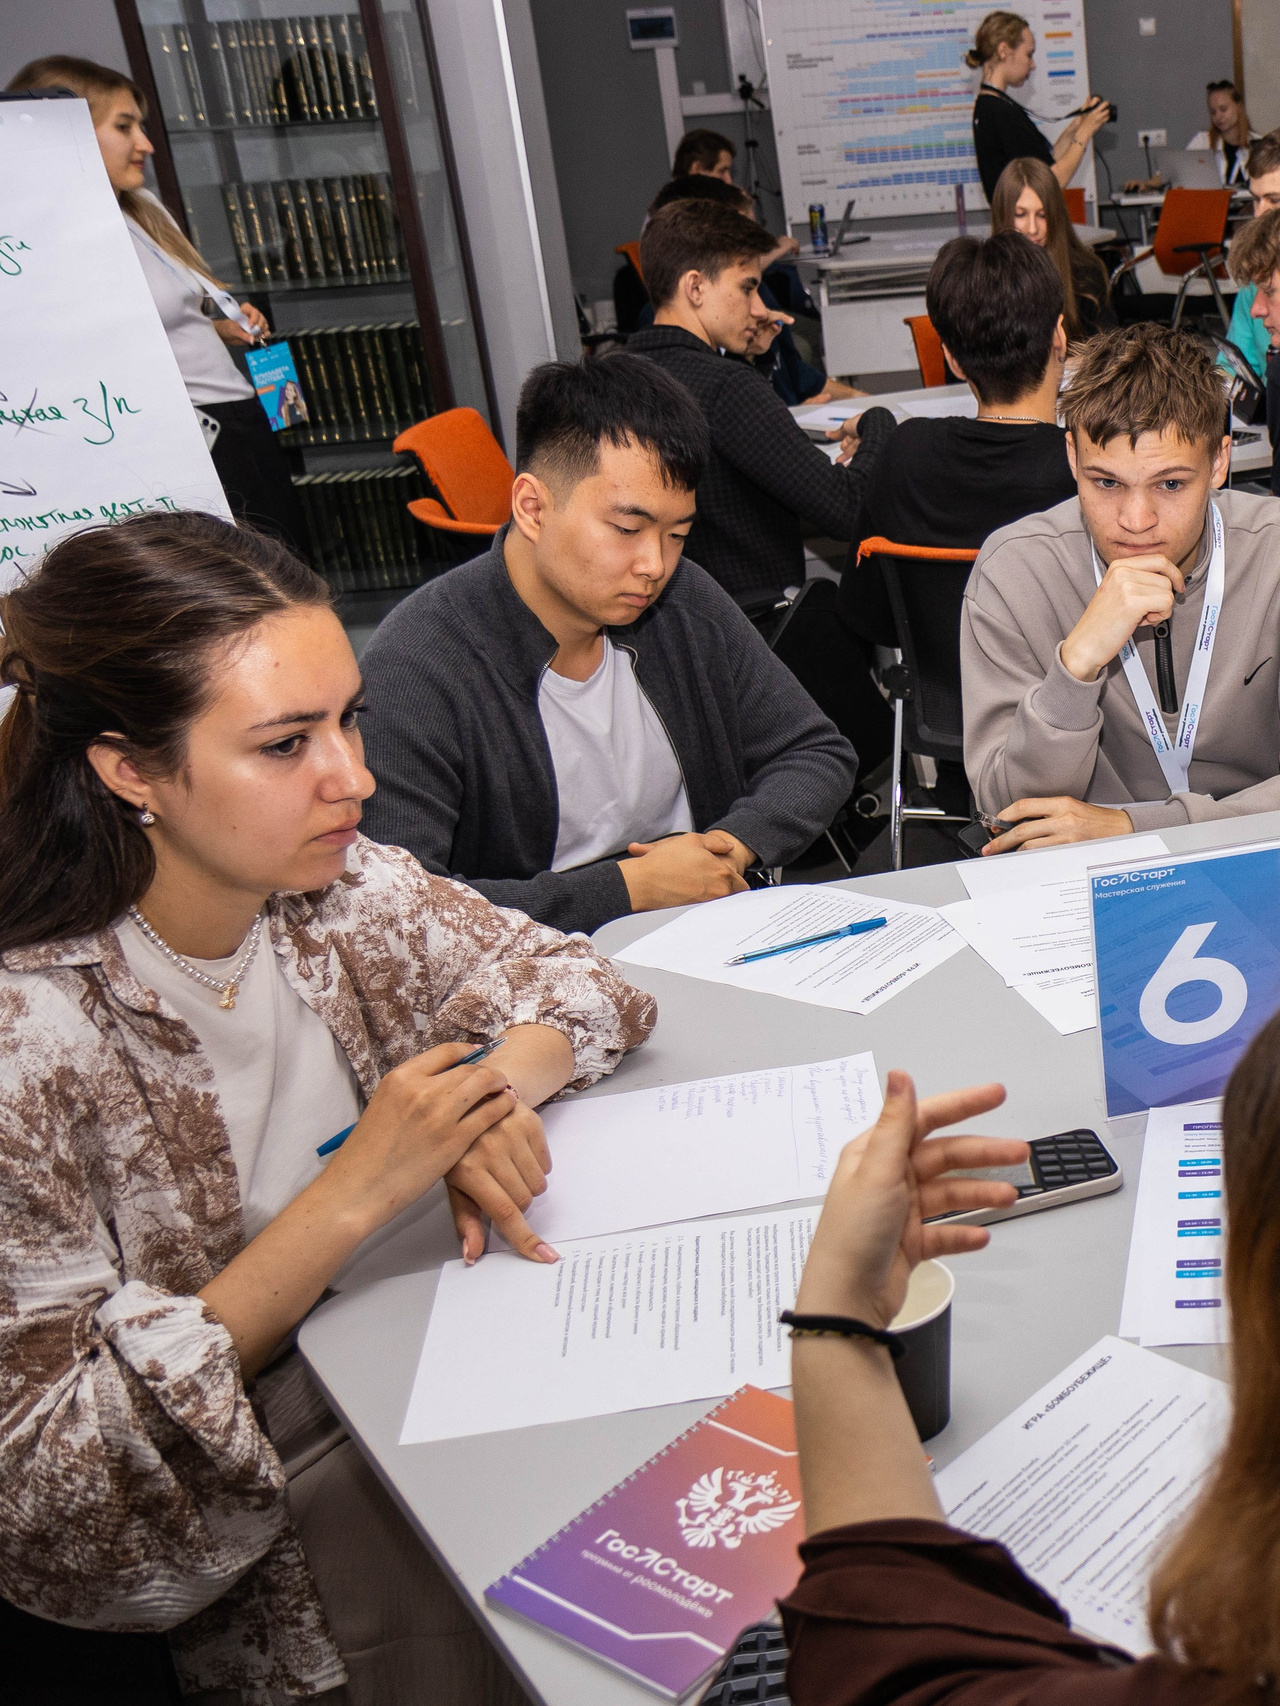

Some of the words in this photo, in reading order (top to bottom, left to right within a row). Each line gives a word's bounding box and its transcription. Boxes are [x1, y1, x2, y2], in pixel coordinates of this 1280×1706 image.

[0, 508, 94, 532] понятная
[1095, 886, 1145, 899] Мастерская
[1146, 880, 1187, 892] служения
[1139, 921, 1248, 1046] 6
[1022, 1413, 1045, 1431] ИГРА
[1045, 1355, 1112, 1412] «БОМБОУБЕЖИЩЕ»
